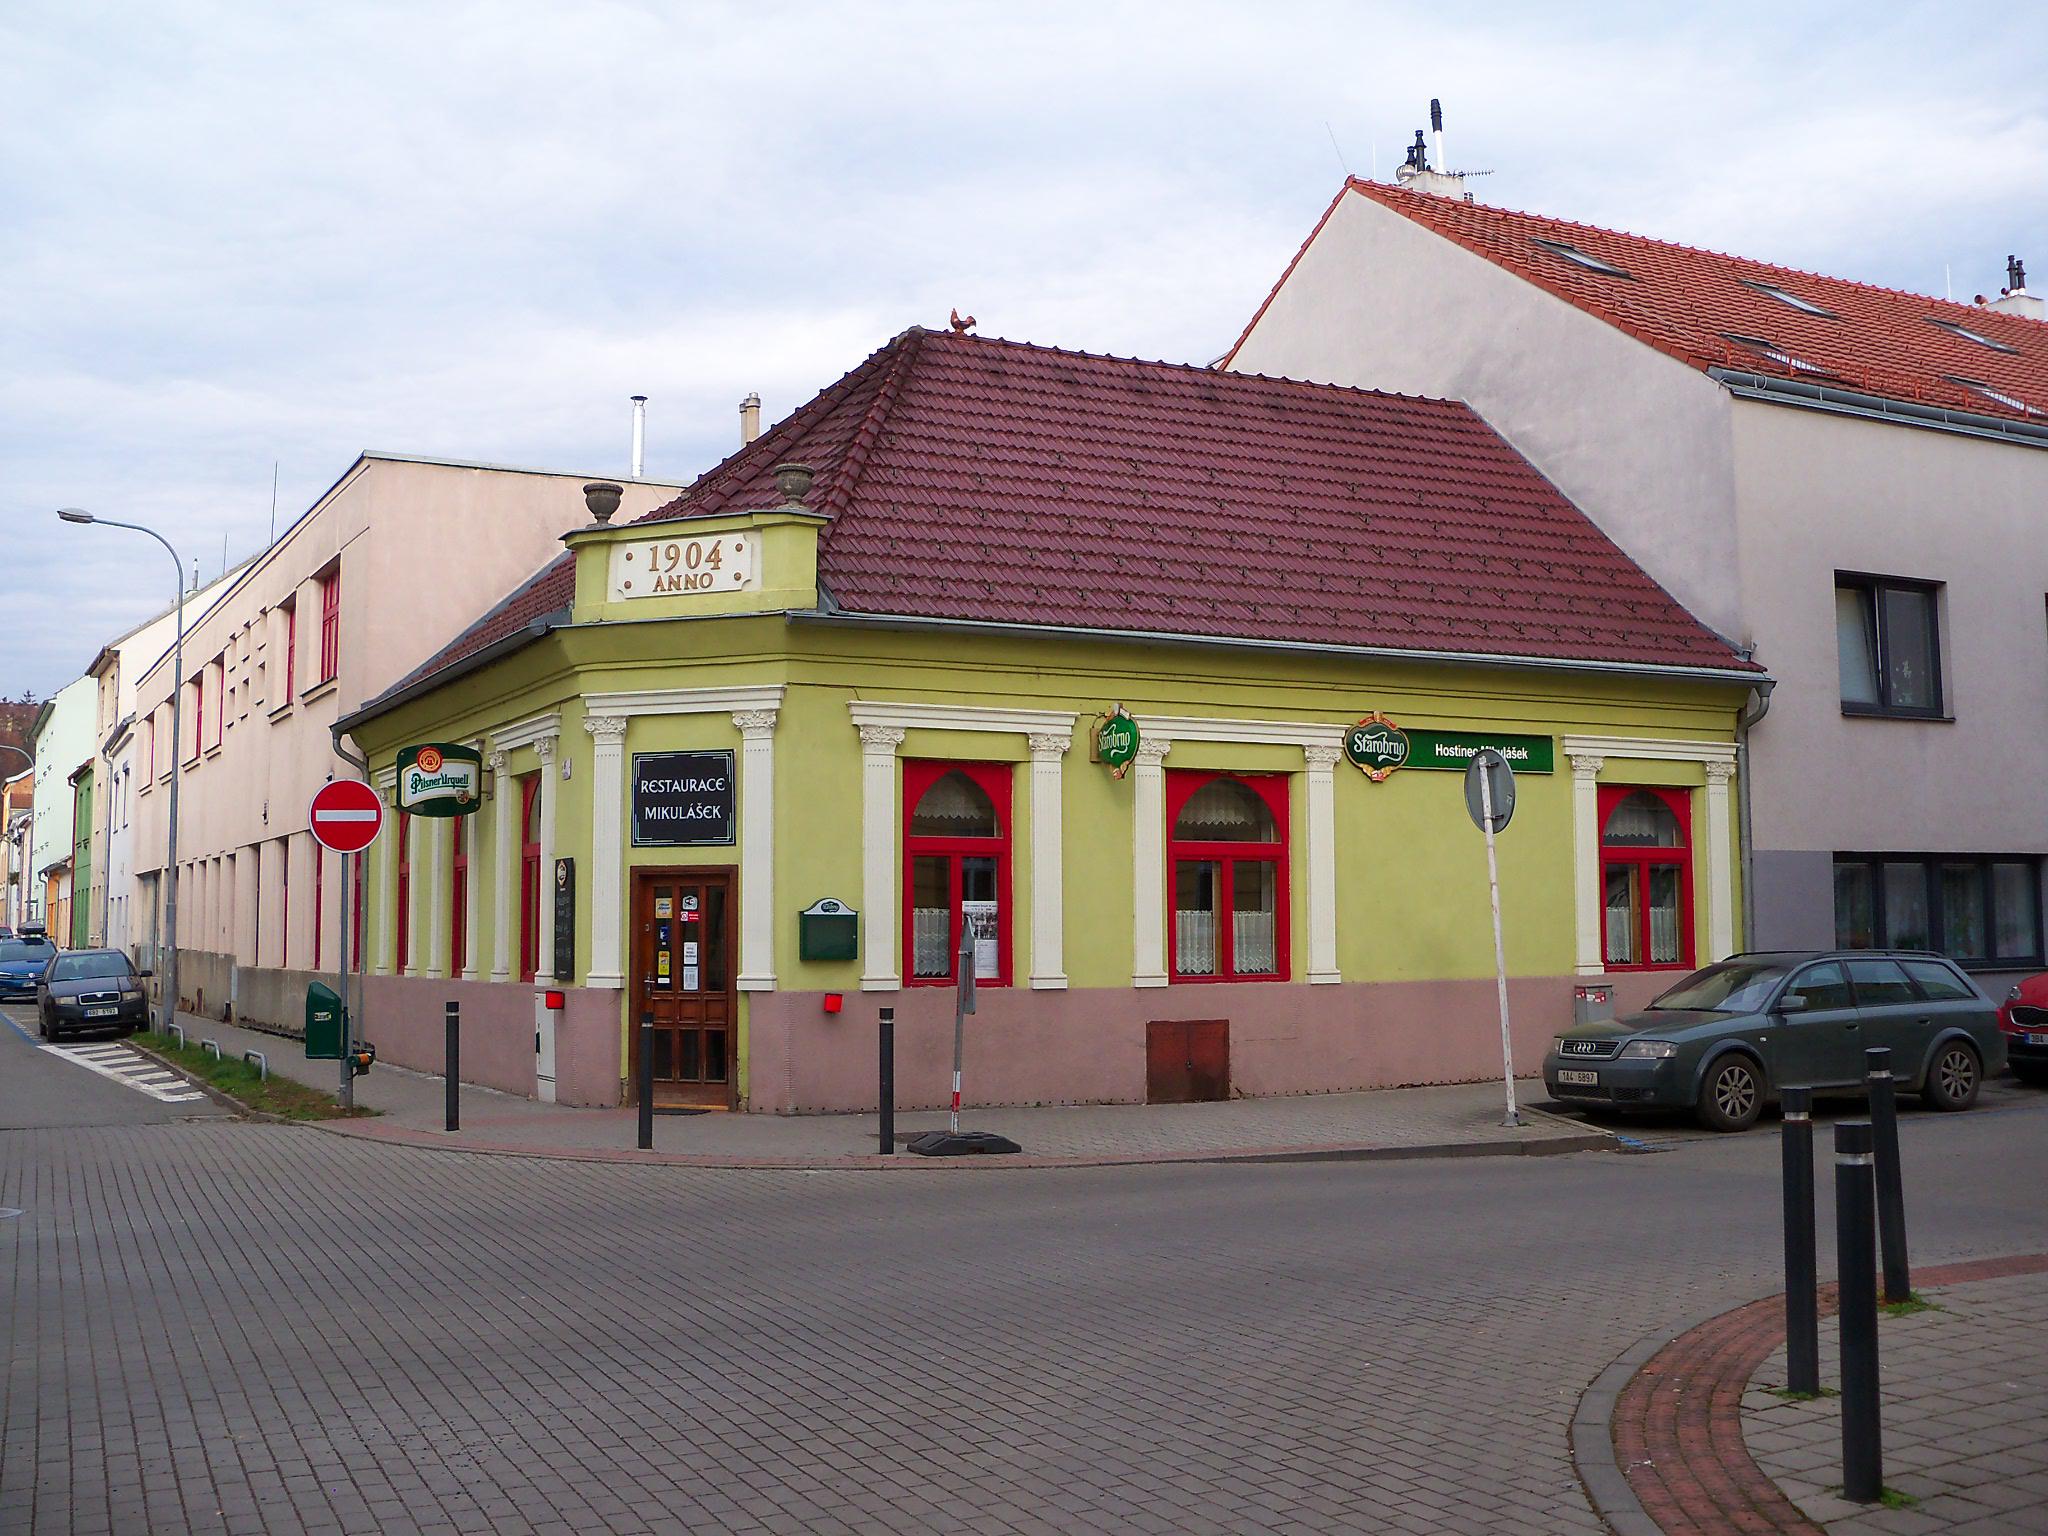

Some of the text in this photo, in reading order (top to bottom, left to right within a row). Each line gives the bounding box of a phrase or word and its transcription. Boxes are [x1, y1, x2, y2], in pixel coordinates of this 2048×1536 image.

[649, 540, 722, 573] 1904
[652, 572, 714, 592] ANNO
[1353, 731, 1405, 762] Starobrno
[1435, 743, 1479, 757] Hostinec
[410, 772, 470, 795] Pilsner Urquell
[641, 778, 725, 793] RESTAURACE
[644, 803, 721, 820] MIKULÁŠEK
